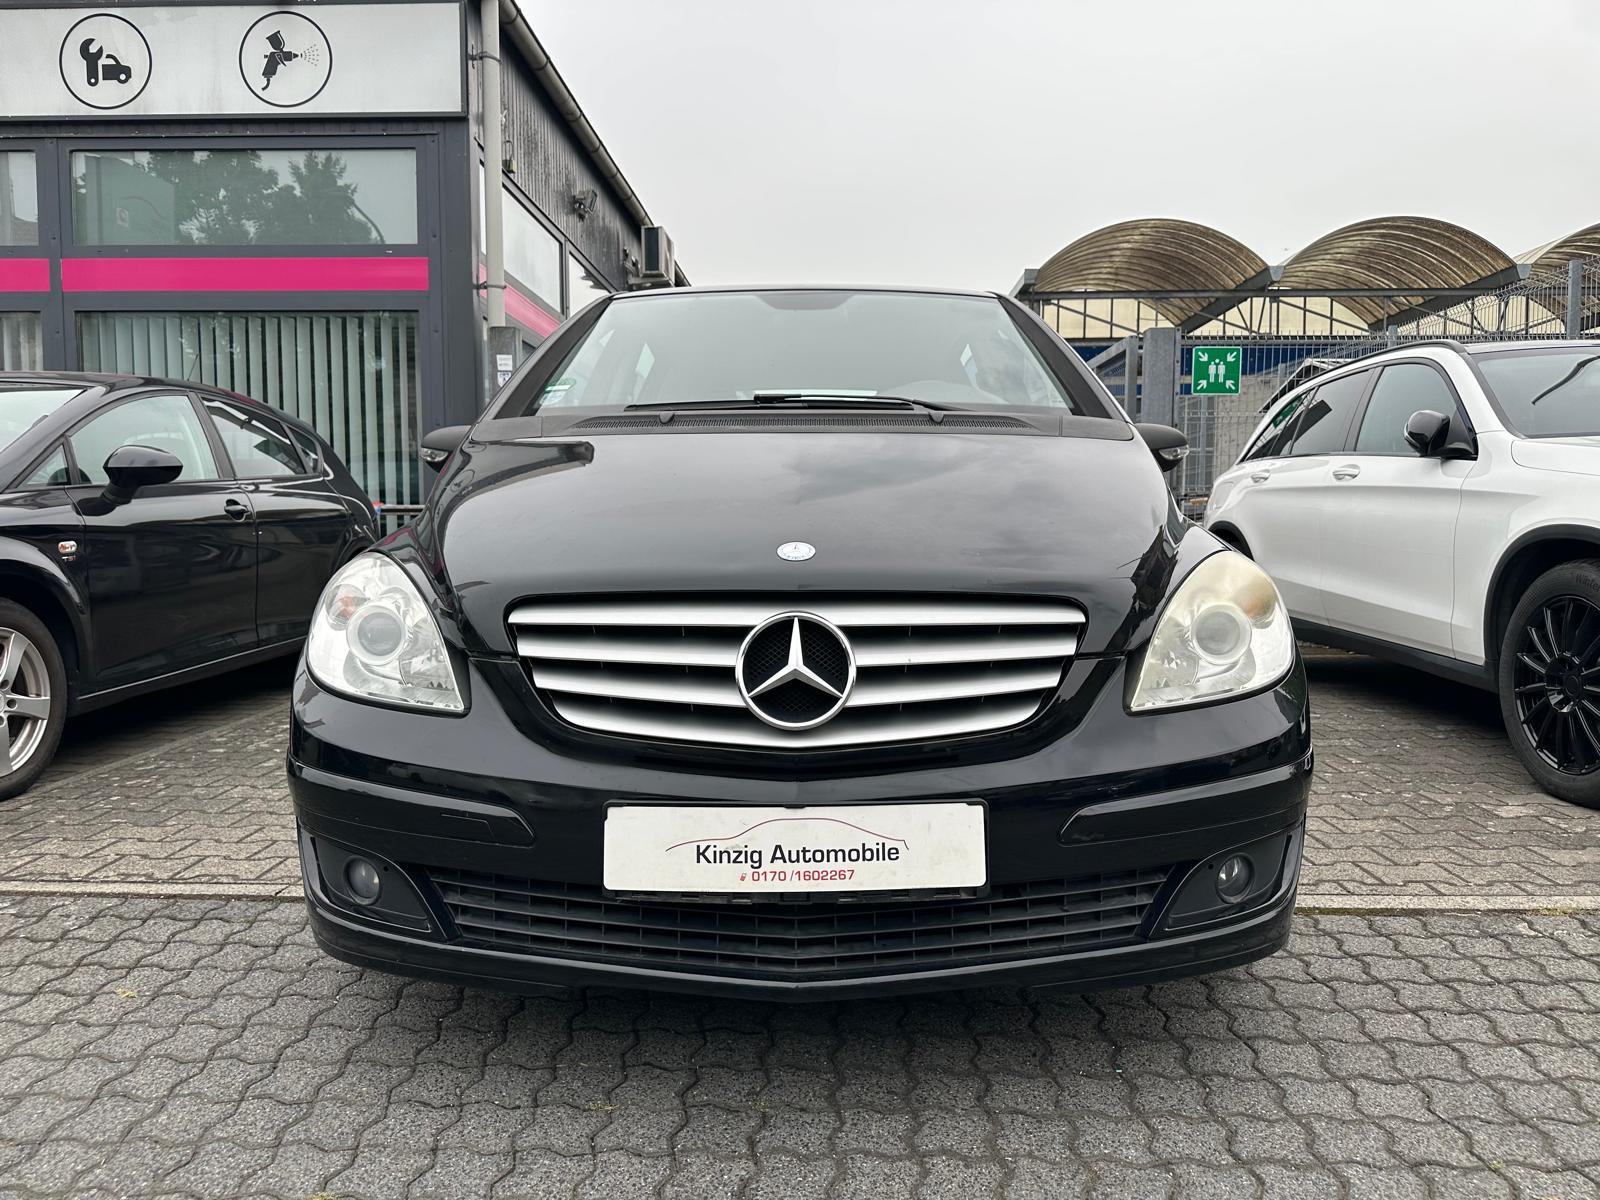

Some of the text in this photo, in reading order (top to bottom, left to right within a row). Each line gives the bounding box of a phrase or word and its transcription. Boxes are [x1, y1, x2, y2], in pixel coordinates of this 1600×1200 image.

[696, 842, 900, 870] Kinzig Automobile
[751, 870, 787, 882] 0170
